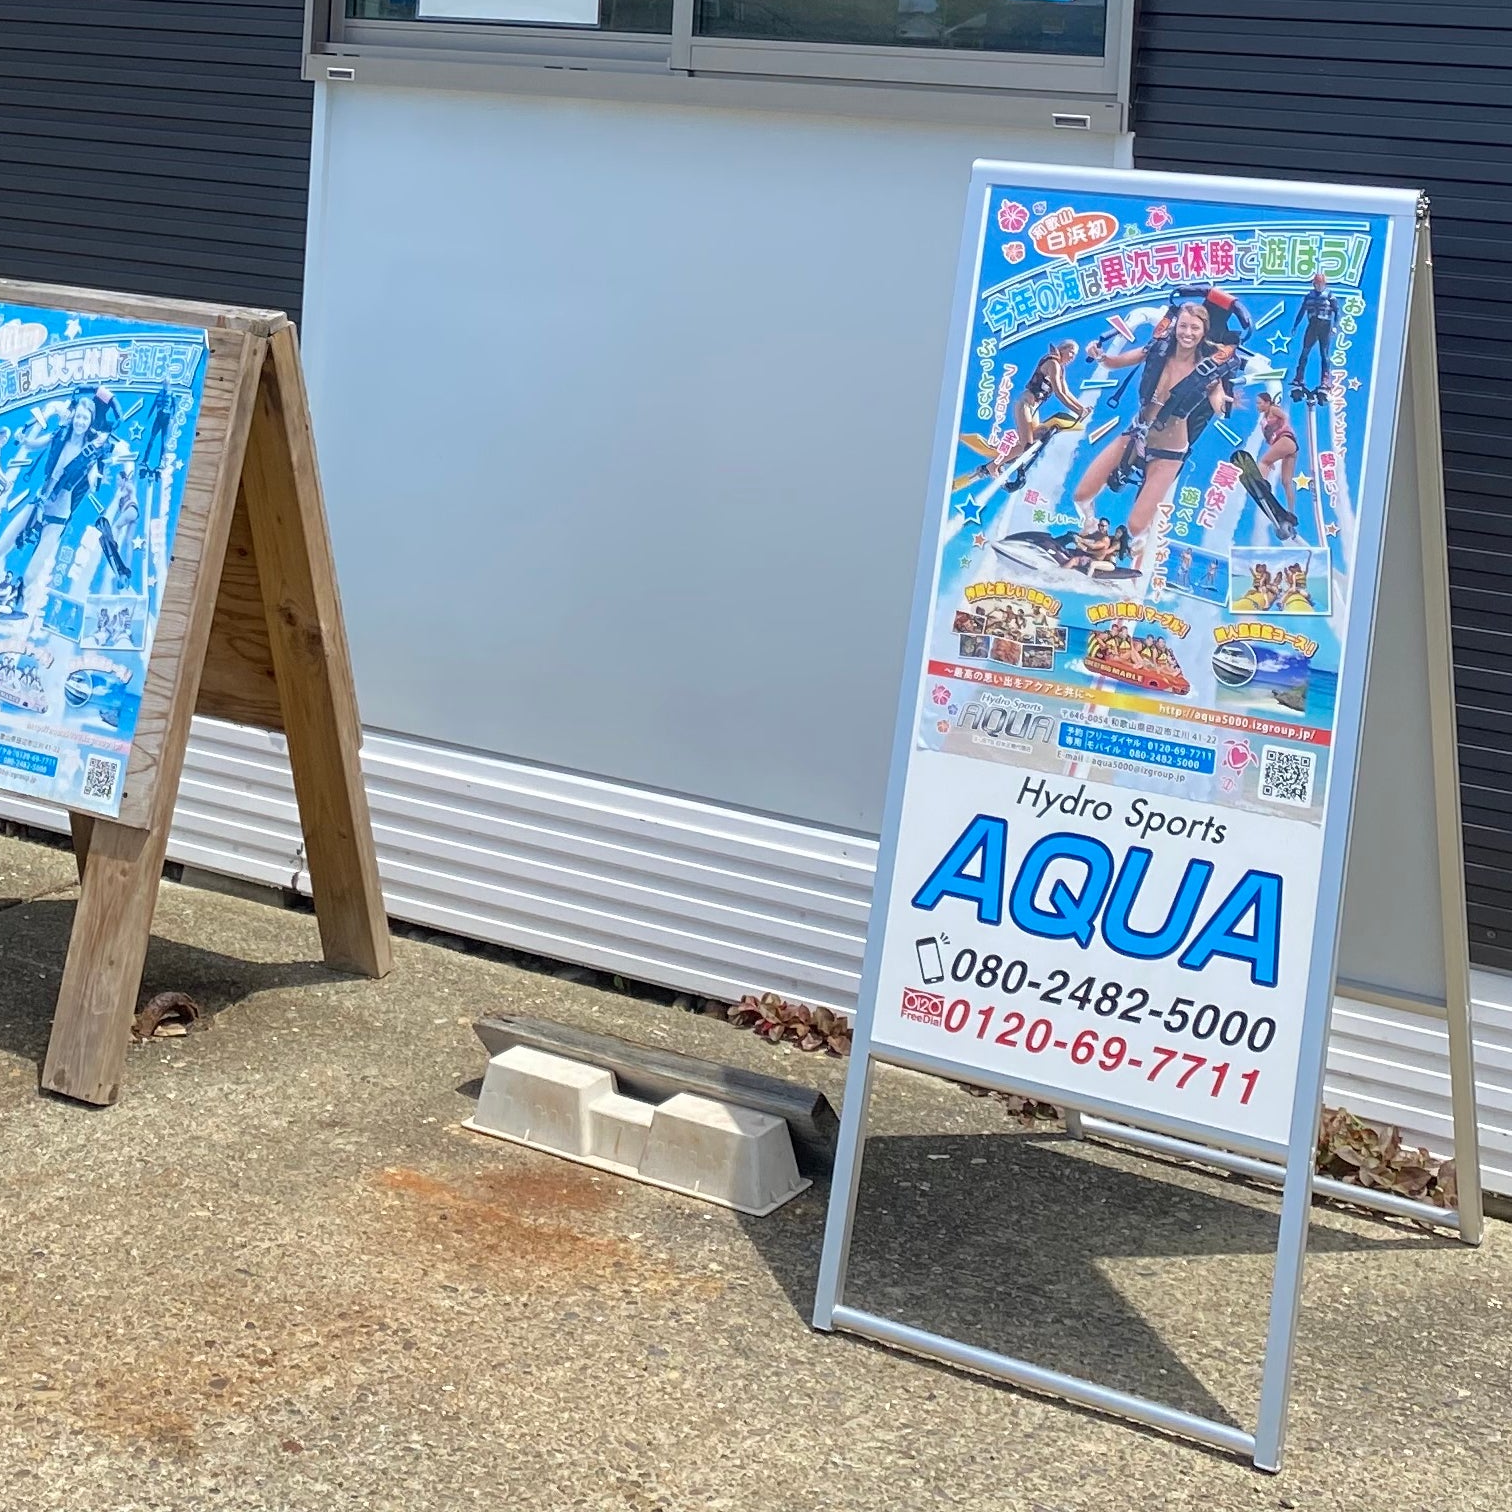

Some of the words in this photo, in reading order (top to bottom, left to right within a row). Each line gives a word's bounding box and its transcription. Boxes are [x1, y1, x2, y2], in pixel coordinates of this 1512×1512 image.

[1046, 220, 1108, 252] 白浜初
[1331, 295, 1365, 367] おもしろ
[977, 338, 997, 419] ぶっとびの
[1176, 486, 1202, 536] 遊べる
[1197, 460, 1242, 529] 豪快に
[956, 702, 1056, 744] AQUA
[982, 693, 1011, 707] Hydro
[1013, 699, 1043, 712] Sports
[1158, 703, 1316, 740] http://aqua5000.izgroup.jp/
[1147, 741, 1213, 761] 0120-69-7711
[1016, 776, 1113, 821] Hydro
[1124, 797, 1228, 844] Sports
[910, 813, 1284, 988] AQUA
[950, 947, 1277, 1053] 080-2482-5000
[943, 998, 1261, 1105] 0120-69-7711
